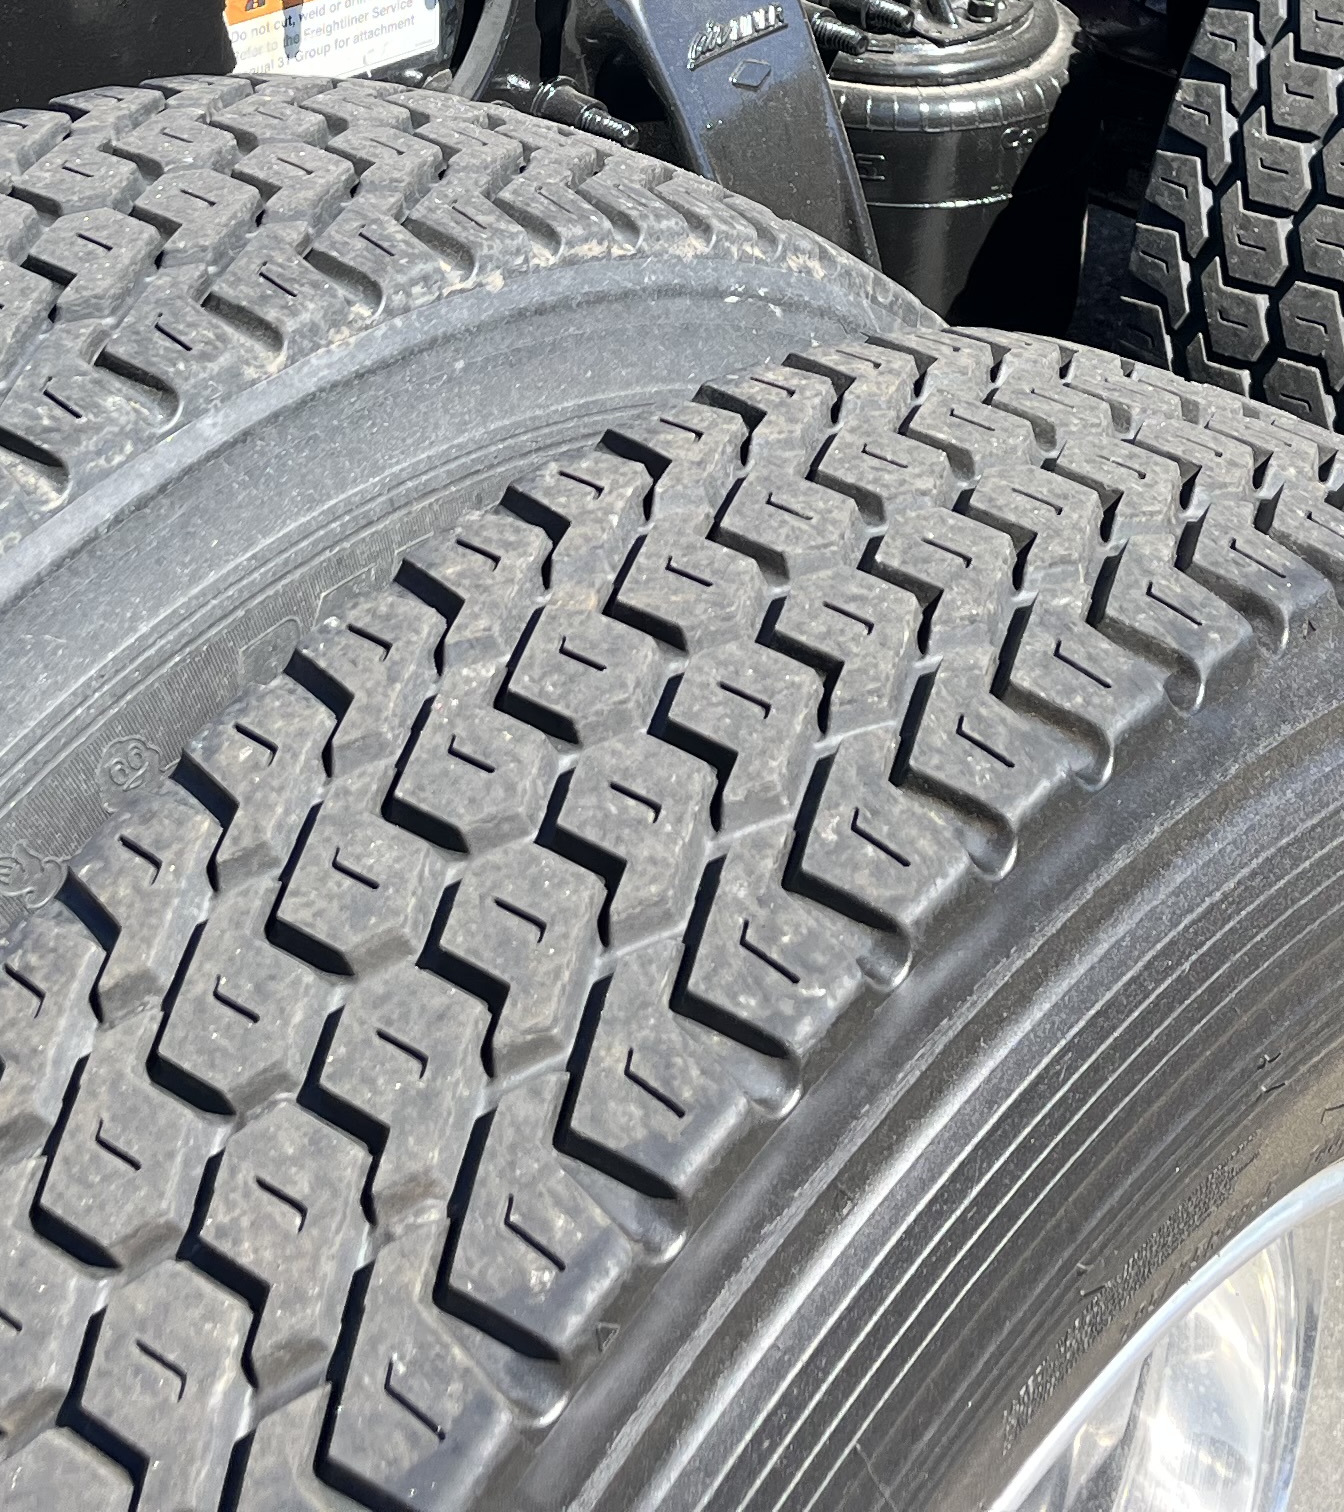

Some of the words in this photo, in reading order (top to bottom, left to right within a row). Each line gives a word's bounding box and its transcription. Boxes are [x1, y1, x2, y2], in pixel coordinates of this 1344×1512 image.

[230, 29, 247, 44] Do
[251, 21, 270, 37] not
[274, 14, 296, 31] cut,
[299, 3, 326, 22] weld
[330, 1, 342, 14] or
[296, 41, 331, 63] Group
[334, 36, 351, 52] for
[353, 14, 415, 43] attachment
[303, 12, 369, 37] Freightliner
